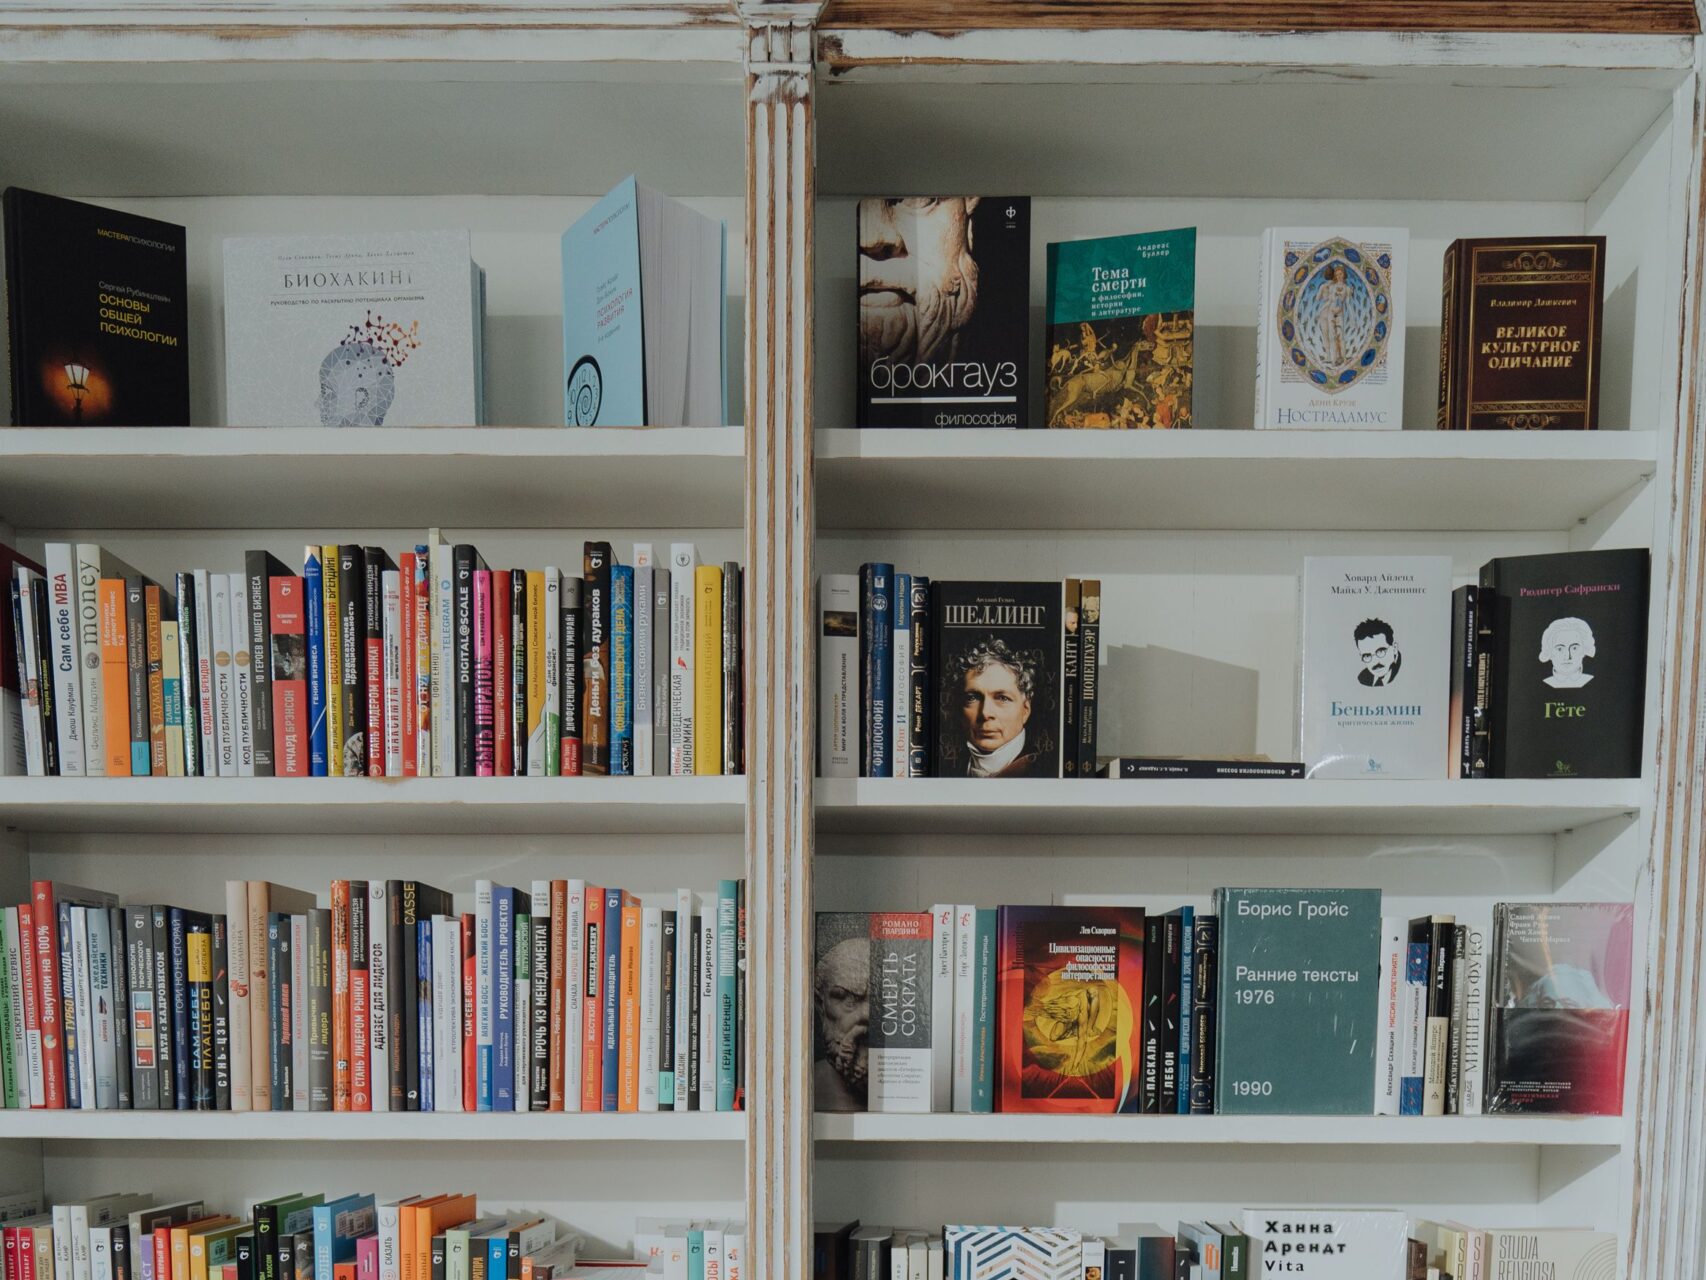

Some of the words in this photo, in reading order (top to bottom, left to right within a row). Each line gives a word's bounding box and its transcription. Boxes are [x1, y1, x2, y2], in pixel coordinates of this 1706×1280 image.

[284, 270, 415, 289] БИОХАКИНГ
[1090, 275, 1147, 294] смерти
[1091, 265, 1129, 282] Тема
[99, 293, 150, 313] ОСНОВЫ
[100, 307, 142, 325] ОБЩЕЙ
[100, 321, 178, 346] ПСИХОЛОГИИ
[1481, 340, 1580, 356] КУЛЬТУРНОЕ
[1496, 325, 1567, 340] ВЕЛИКОЕ
[870, 355, 1017, 397] брокгауз
[1488, 355, 1573, 369] ОДИЧАНИЕ
[934, 411, 1017, 429] философия
[78, 559, 101, 646] money
[251, 576, 262, 611] БИЗНЕСА
[57, 609, 70, 641] себе
[253, 611, 263, 642] ВАШЕГО
[441, 599, 451, 651] TELEGRAM
[591, 589, 603, 643] дураков
[944, 605, 1046, 625] ШЕЛЛИНГ
[460, 586, 470, 683] DIGITAL@SCALE
[58, 644, 73, 673] Сам
[254, 643, 264, 674] ГЕРОЕВ
[368, 646, 379, 682] РЫНКА!
[589, 644, 600, 669] без
[1066, 640, 1078, 678] КАНТ
[1083, 629, 1096, 701] ШОПЕНГАУЭР
[255, 674, 265, 684] 10
[590, 670, 602, 718] Деньги
[219, 673, 231, 744] ПУБЛИЧНОСТИ
[239, 673, 250, 744] ПУБЛИЧНОСТИ
[283, 690, 295, 733] БРЭНСОН
[369, 684, 380, 729] ЛИДЕРОМ
[673, 674, 682, 744] ПОВЕДЕНЧЕСКАЯ
[1330, 699, 1422, 719] Беньямин
[1543, 701, 1586, 719] Гёте
[370, 731, 381, 759] СТАНЬ
[682, 717, 693, 775] ЭКОНОМИКА
[873, 699, 884, 767] ФИЛОСОФИЯ
[222, 745, 233, 766] КОД
[241, 745, 252, 765] КОД
[285, 734, 297, 773] РИЧАРД
[404, 883, 416, 925] CASSE
[1237, 900, 1292, 919] Борис
[1298, 900, 1349, 920] Гройс
[498, 899, 509, 946] ПРОЕКТОВ
[882, 920, 920, 929] РОМАНО
[38, 925, 50, 954] 100%
[704, 927, 714, 980] директора
[9, 947, 18, 983] СЕРВИС
[42, 959, 51, 972] на
[62, 950, 74, 999] КОМАНДА
[534, 925, 547, 1006] МЕНЕДЖМЕНТА!
[607, 954, 616, 1006] РУКОВОДИТЕЛЬ
[1235, 965, 1298, 982] Ранние
[1303, 968, 1359, 983] тексты
[43, 975, 56, 1024] Закупки
[354, 977, 365, 1011] РЫНКА!
[464, 976, 473, 996] БОСС
[498, 948, 509, 1020] РУКОВОДИТЕЛЬ
[703, 981, 713, 998] Ген
[881, 952, 900, 1037] СМЕРТЬ
[901, 953, 917, 1037] СОКРАТА
[1233, 989, 1275, 1005] 1976
[11, 984, 22, 1040] ИСКРЕННИЙ
[64, 1000, 76, 1031] ТУРБО
[190, 988, 200, 1031] СЕБЕ
[309, 999, 319, 1045] Привычки
[464, 997, 473, 1018] СЕБЕ
[534, 1008, 547, 1023] ИЗ
[722, 993, 731, 1047] ГИГЕРЕНЦЕР
[201, 989, 213, 1069] ПЛАЦЕБО
[320, 1012, 329, 1045] лидера
[354, 1014, 365, 1056] ЛИДЕРОМ
[464, 1019, 473, 1037] САМ
[534, 1025, 547, 1058] ПРОЧЬ
[607, 1008, 616, 1050] ИДЕАЛЬНЫЙ
[192, 1036, 201, 1069] САМ
[722, 1048, 732, 1071] ГЕРД
[1146, 1037, 1157, 1092] ПАСКАЛЬ
[355, 1060, 365, 1087] СТАНЬ
[1163, 1051, 1175, 1090] ЛЕБОН
[1231, 1080, 1272, 1097] 1990
[1264, 1220, 1335, 1235] Ханна
[1264, 1240, 1347, 1256] Арендт
[1499, 1235, 1539, 1260] STUDIA
[1264, 1260, 1306, 1272] Vita
